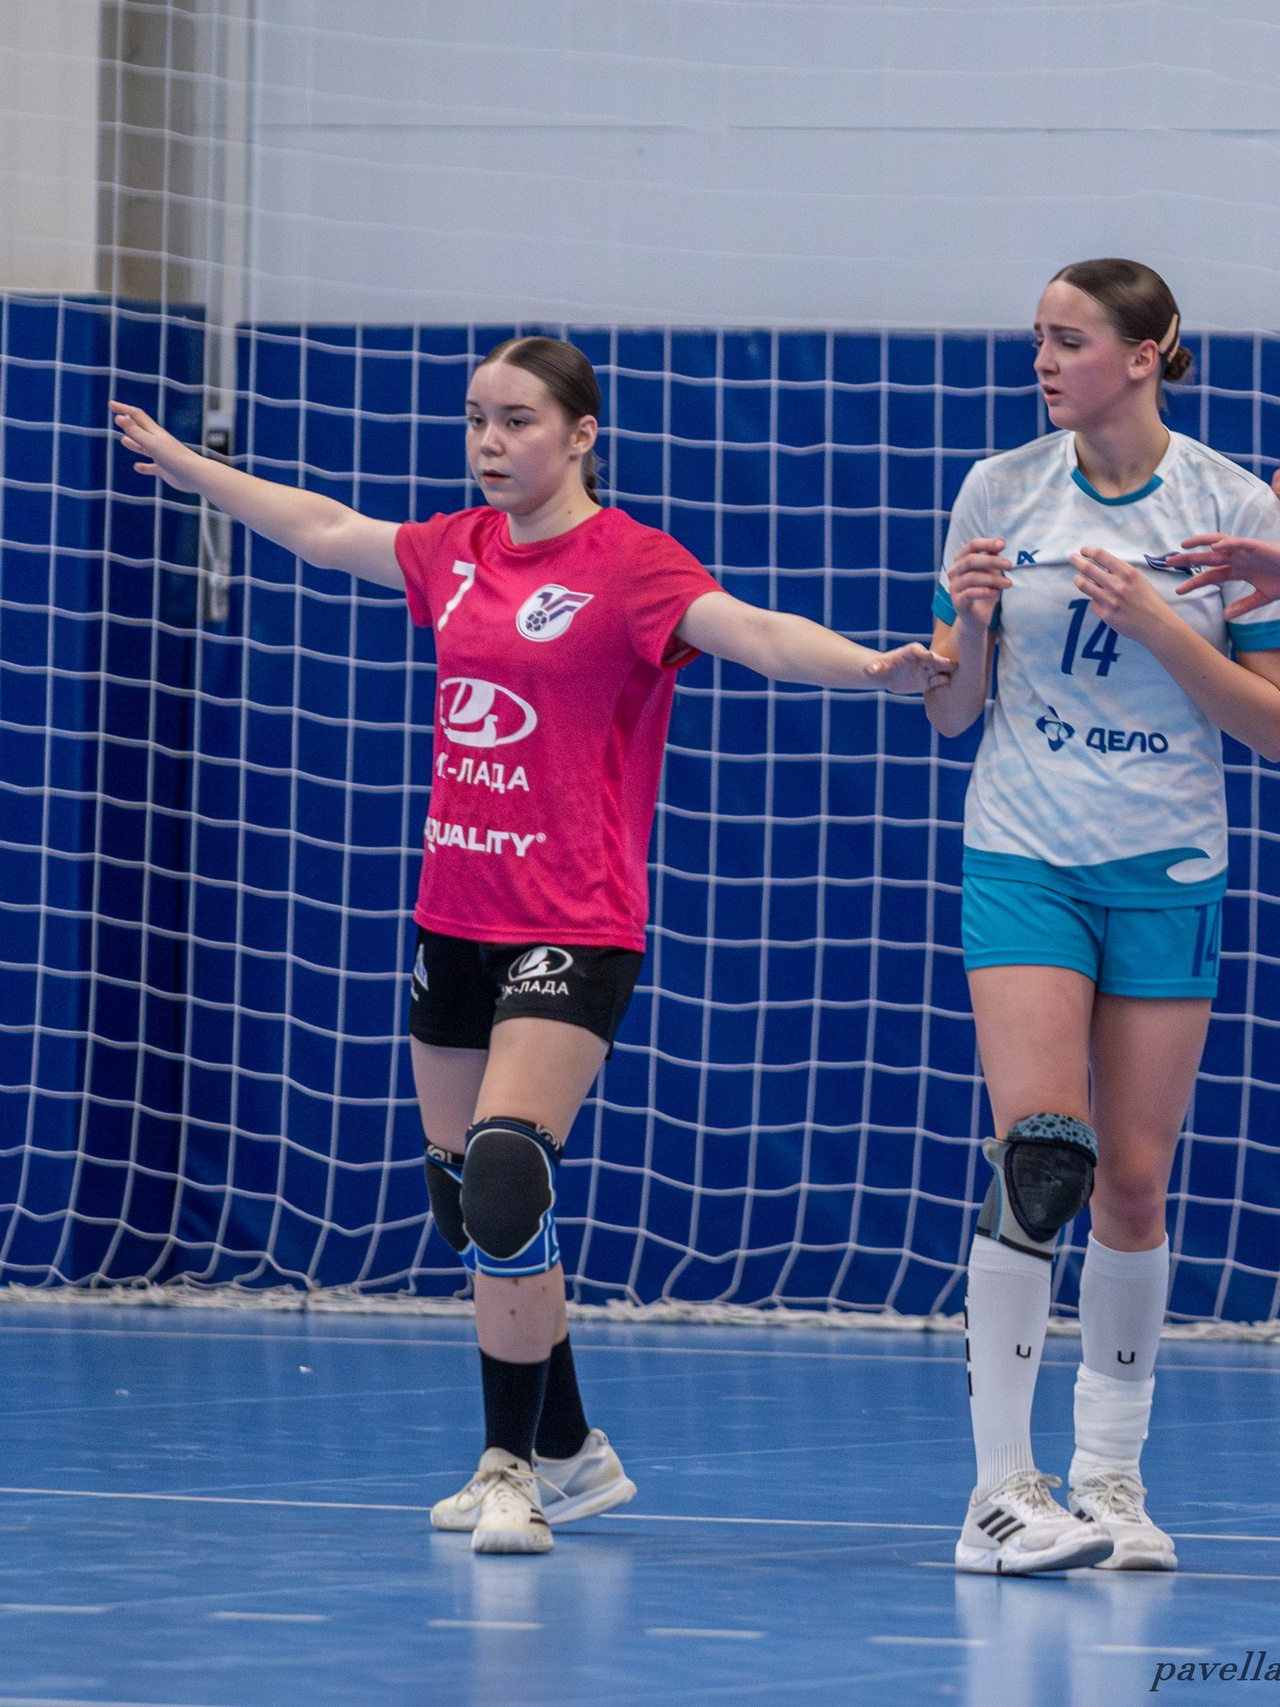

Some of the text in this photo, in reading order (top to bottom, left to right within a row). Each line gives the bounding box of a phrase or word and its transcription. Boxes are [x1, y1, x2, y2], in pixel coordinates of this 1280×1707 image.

[437, 559, 476, 632] 7
[1061, 598, 1121, 677] 14
[1086, 727, 1169, 754] ДЕЛО
